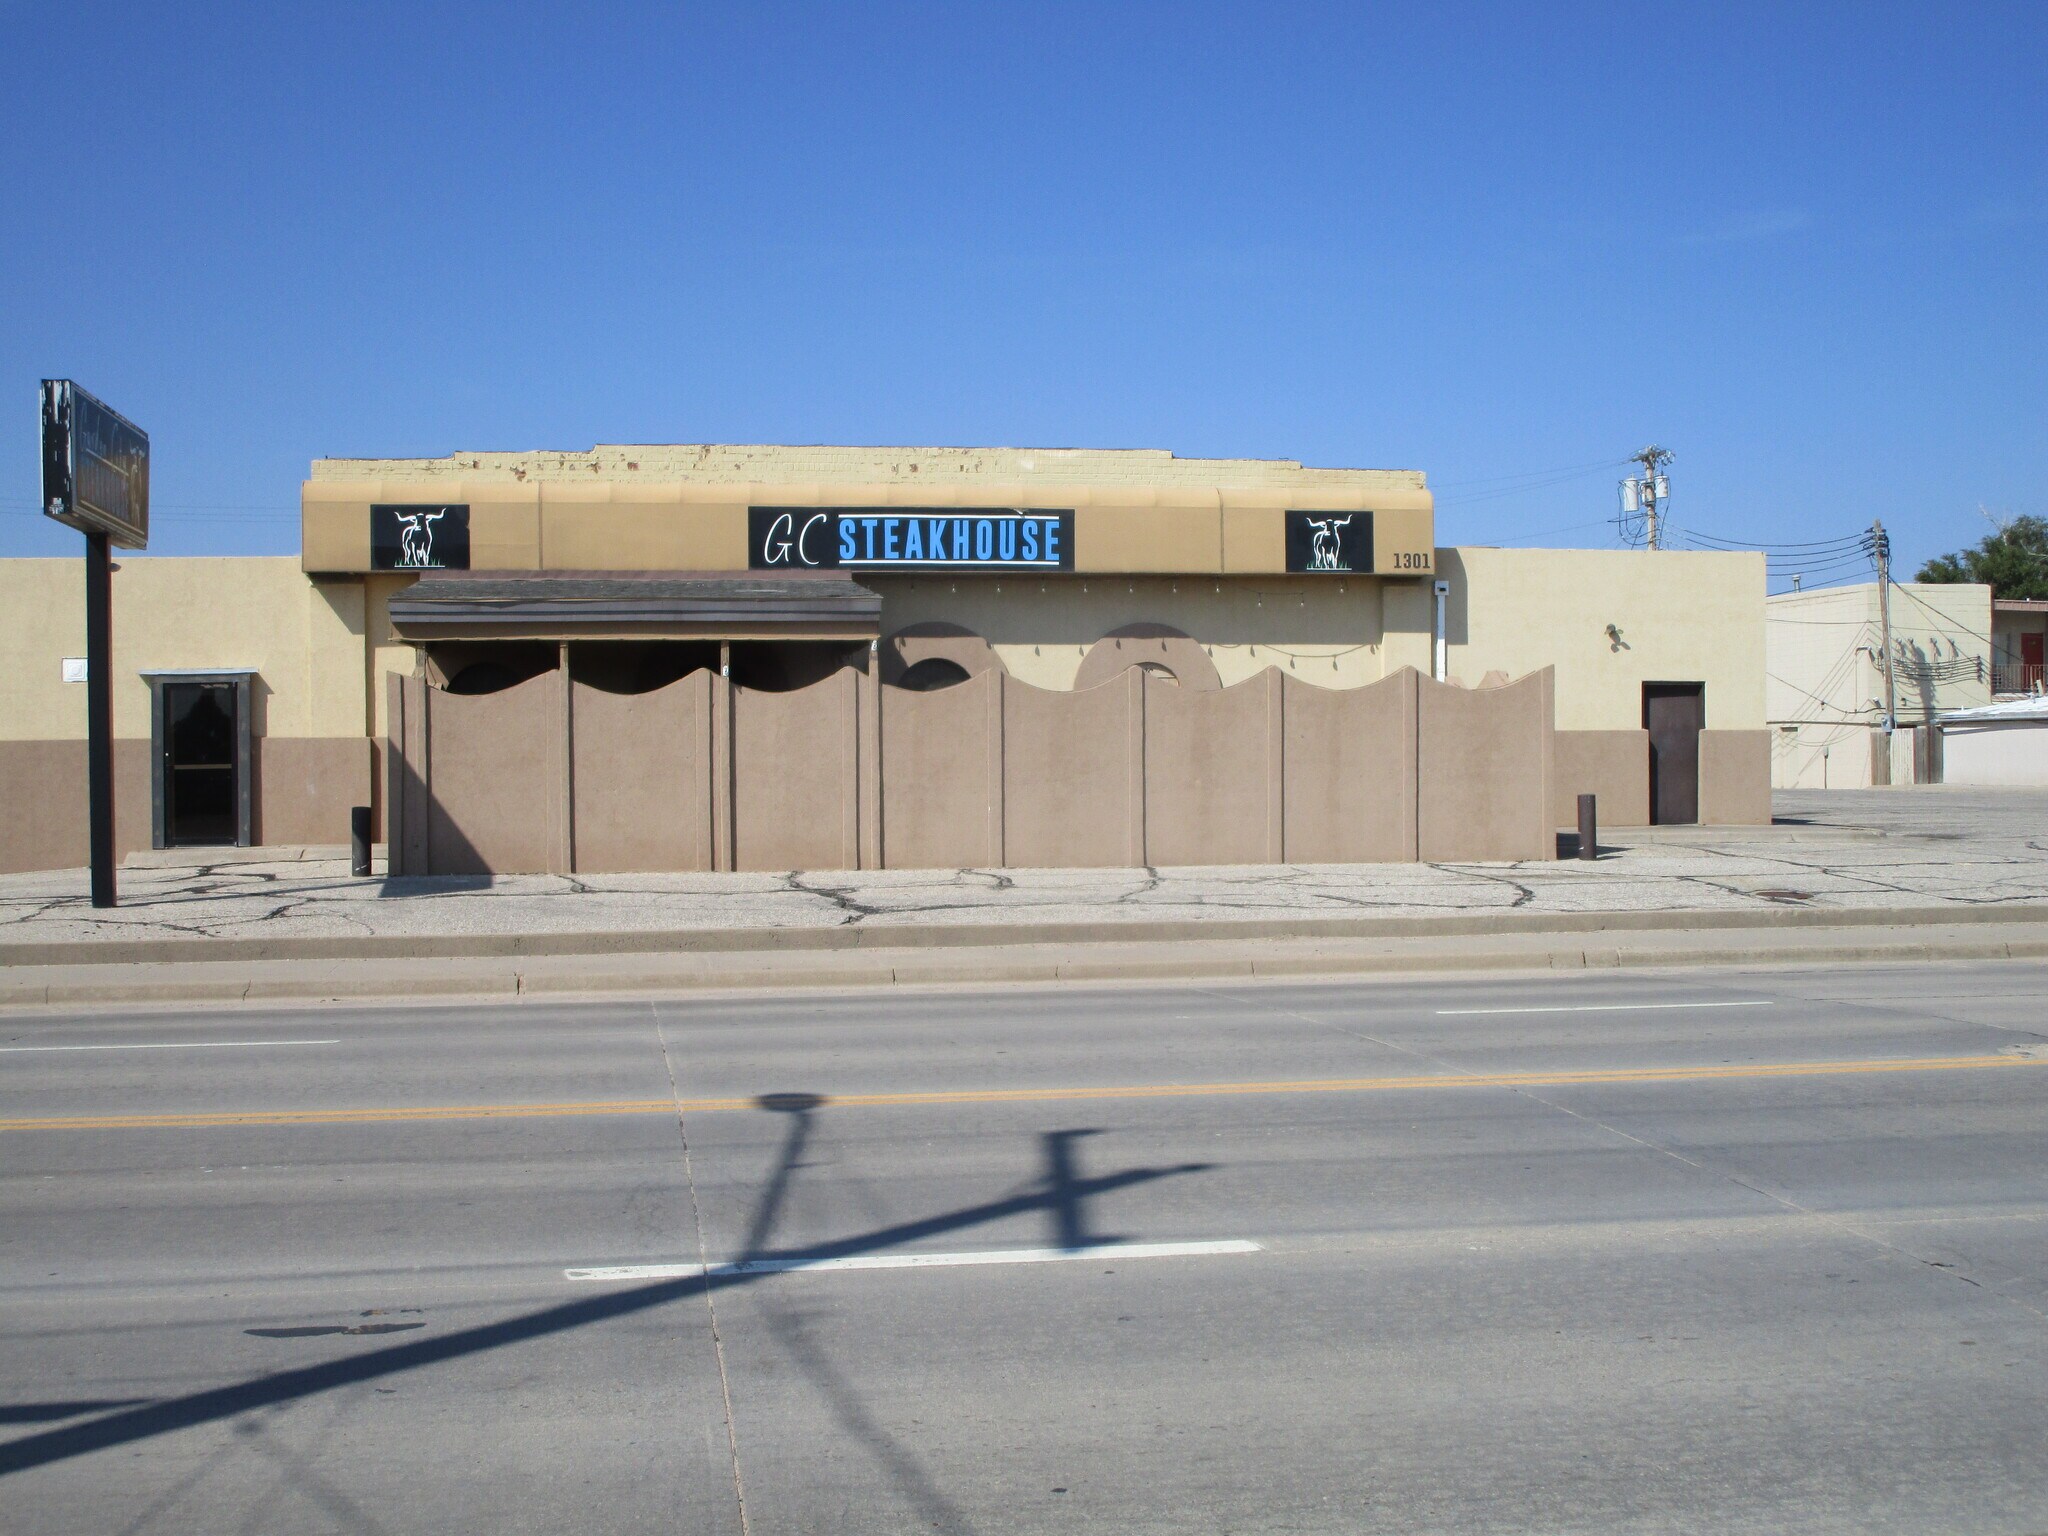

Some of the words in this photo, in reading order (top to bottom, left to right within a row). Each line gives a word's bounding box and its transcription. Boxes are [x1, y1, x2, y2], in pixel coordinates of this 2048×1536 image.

[764, 513, 827, 565] GC
[838, 518, 1060, 561] STEAKHOUSE
[1394, 553, 1431, 569] 1301
